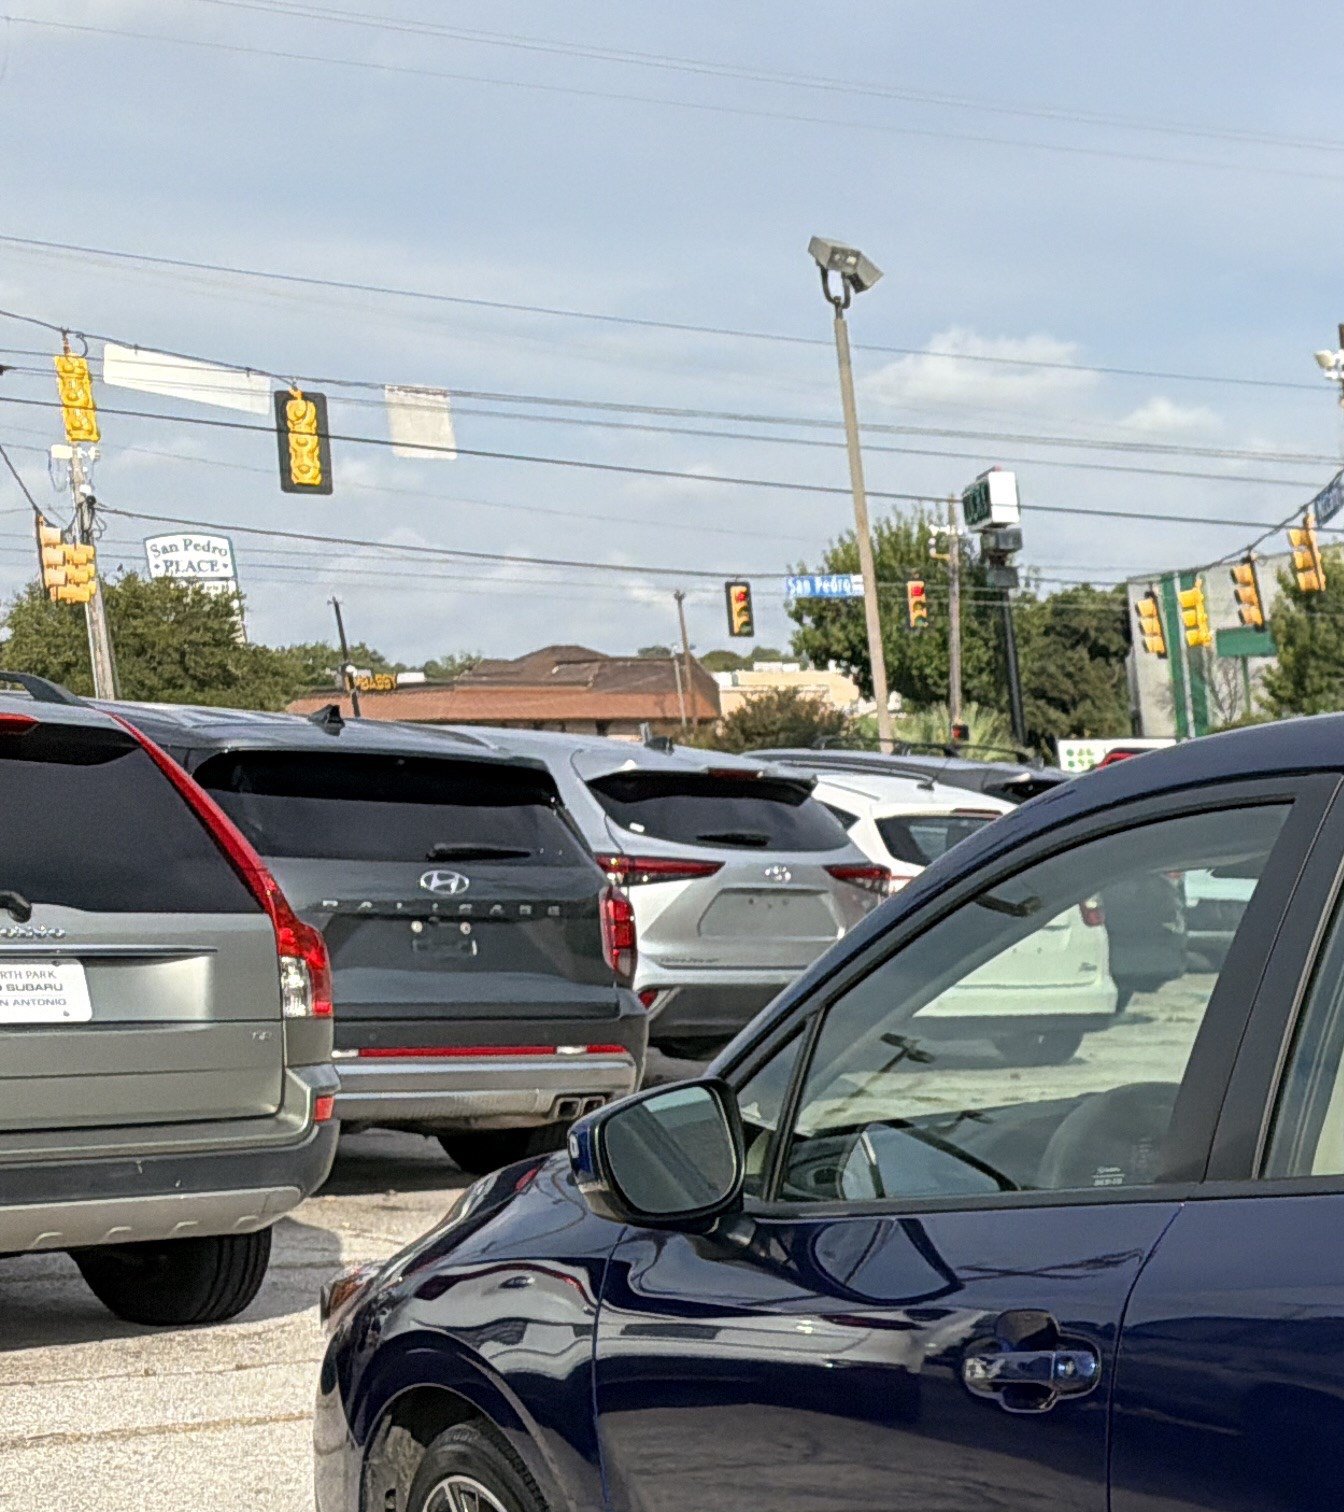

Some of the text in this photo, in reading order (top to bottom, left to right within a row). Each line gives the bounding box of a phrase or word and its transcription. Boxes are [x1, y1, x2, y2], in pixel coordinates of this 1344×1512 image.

[150, 538, 228, 558] San Pedro
[164, 559, 220, 573] PLACE
[0, 970, 57, 980] RTH PARK
[6, 983, 64, 992] SUBARU
[13, 998, 67, 1007] ANTONIO
